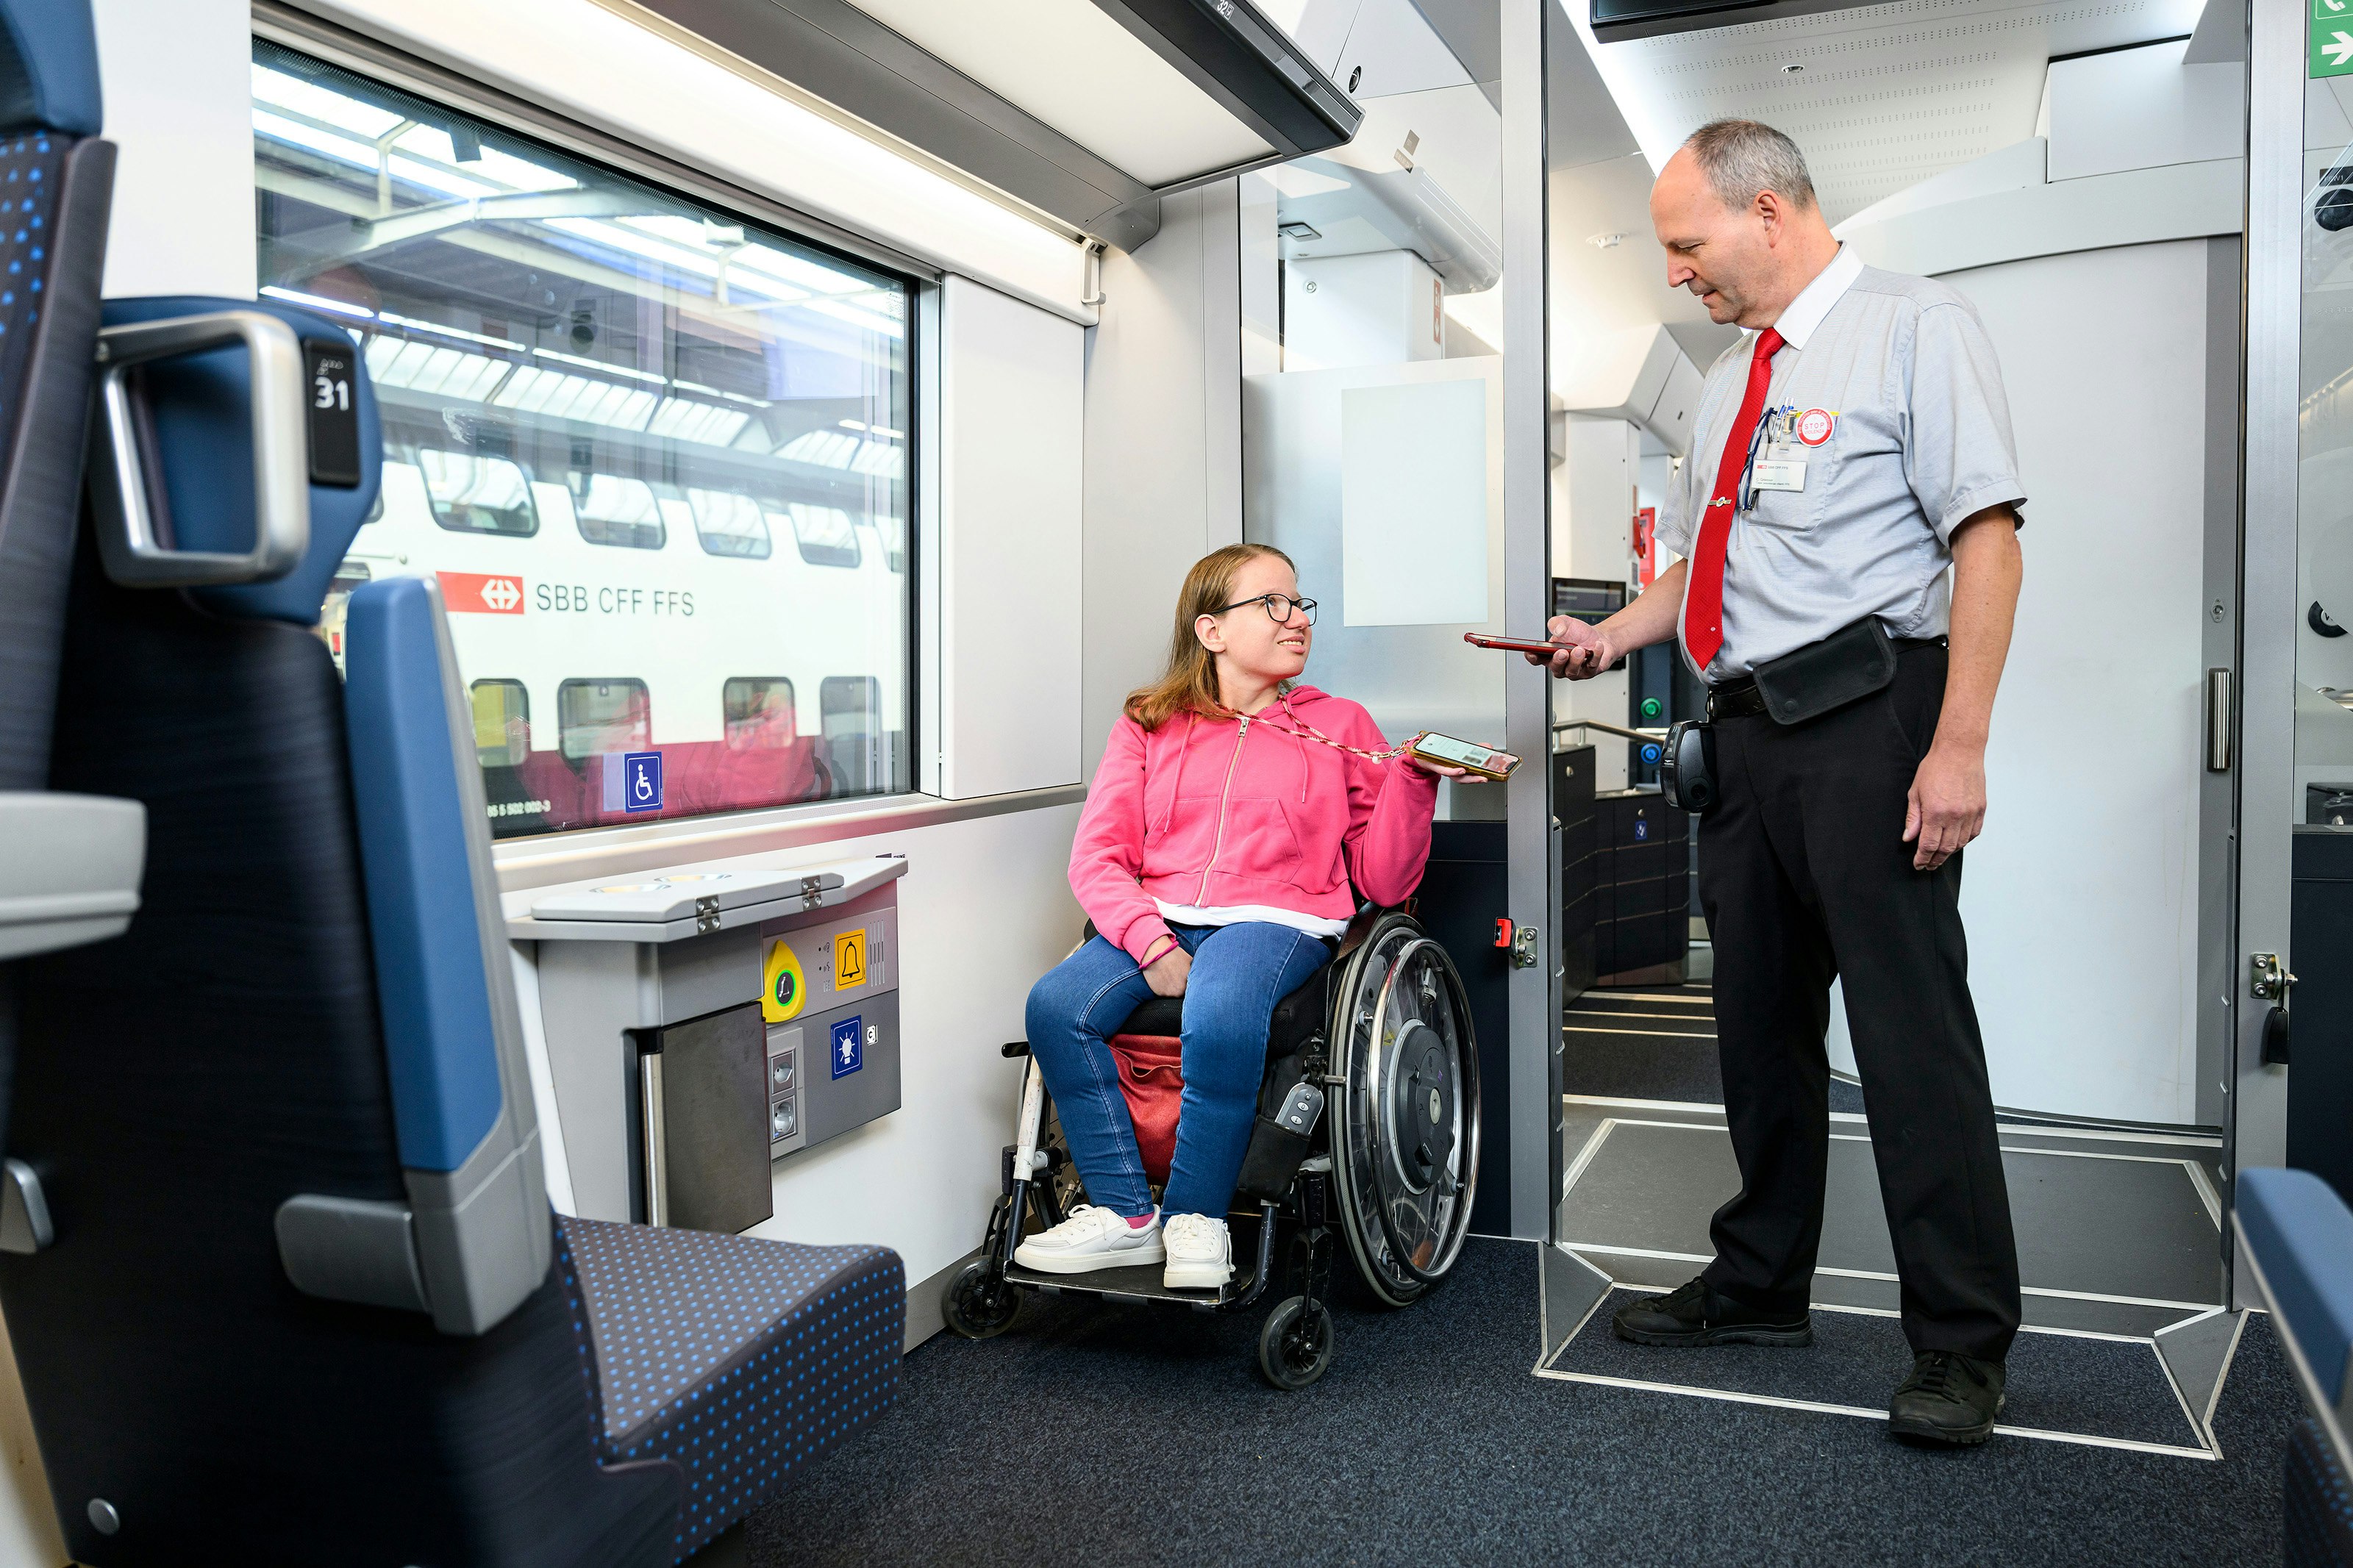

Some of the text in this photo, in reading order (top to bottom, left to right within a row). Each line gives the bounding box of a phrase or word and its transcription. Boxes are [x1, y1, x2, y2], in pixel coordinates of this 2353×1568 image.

[1217, 0, 1229, 15] 32
[315, 376, 349, 411] 31
[1804, 422, 1825, 430] STOP
[537, 584, 694, 616] SBB CFF FFS
[1375, 917, 1417, 940] SCHWALBE
